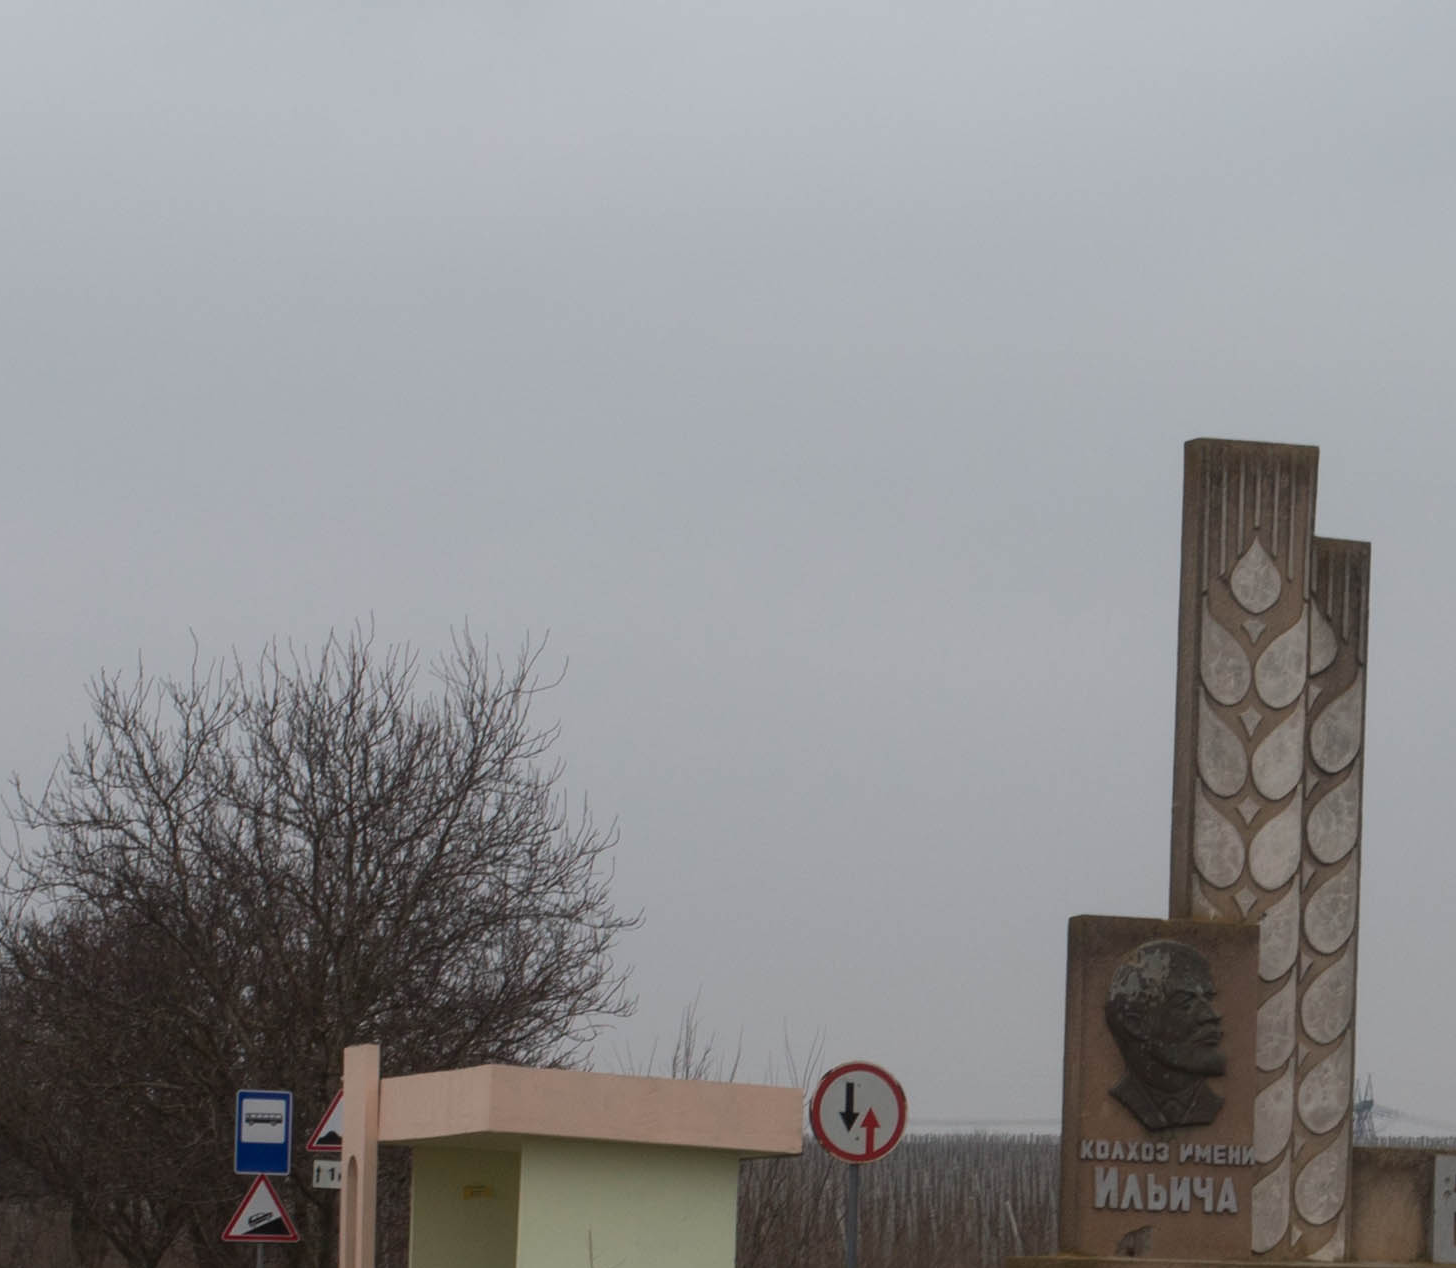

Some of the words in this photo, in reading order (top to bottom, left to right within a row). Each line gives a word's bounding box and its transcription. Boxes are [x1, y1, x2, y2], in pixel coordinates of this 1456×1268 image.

[1081, 1139, 1169, 1162] КОЛХОЗ
[1178, 1143, 1257, 1166] ИМЕНИ
[1094, 1166, 1238, 1213] ИЛЬИЧА
